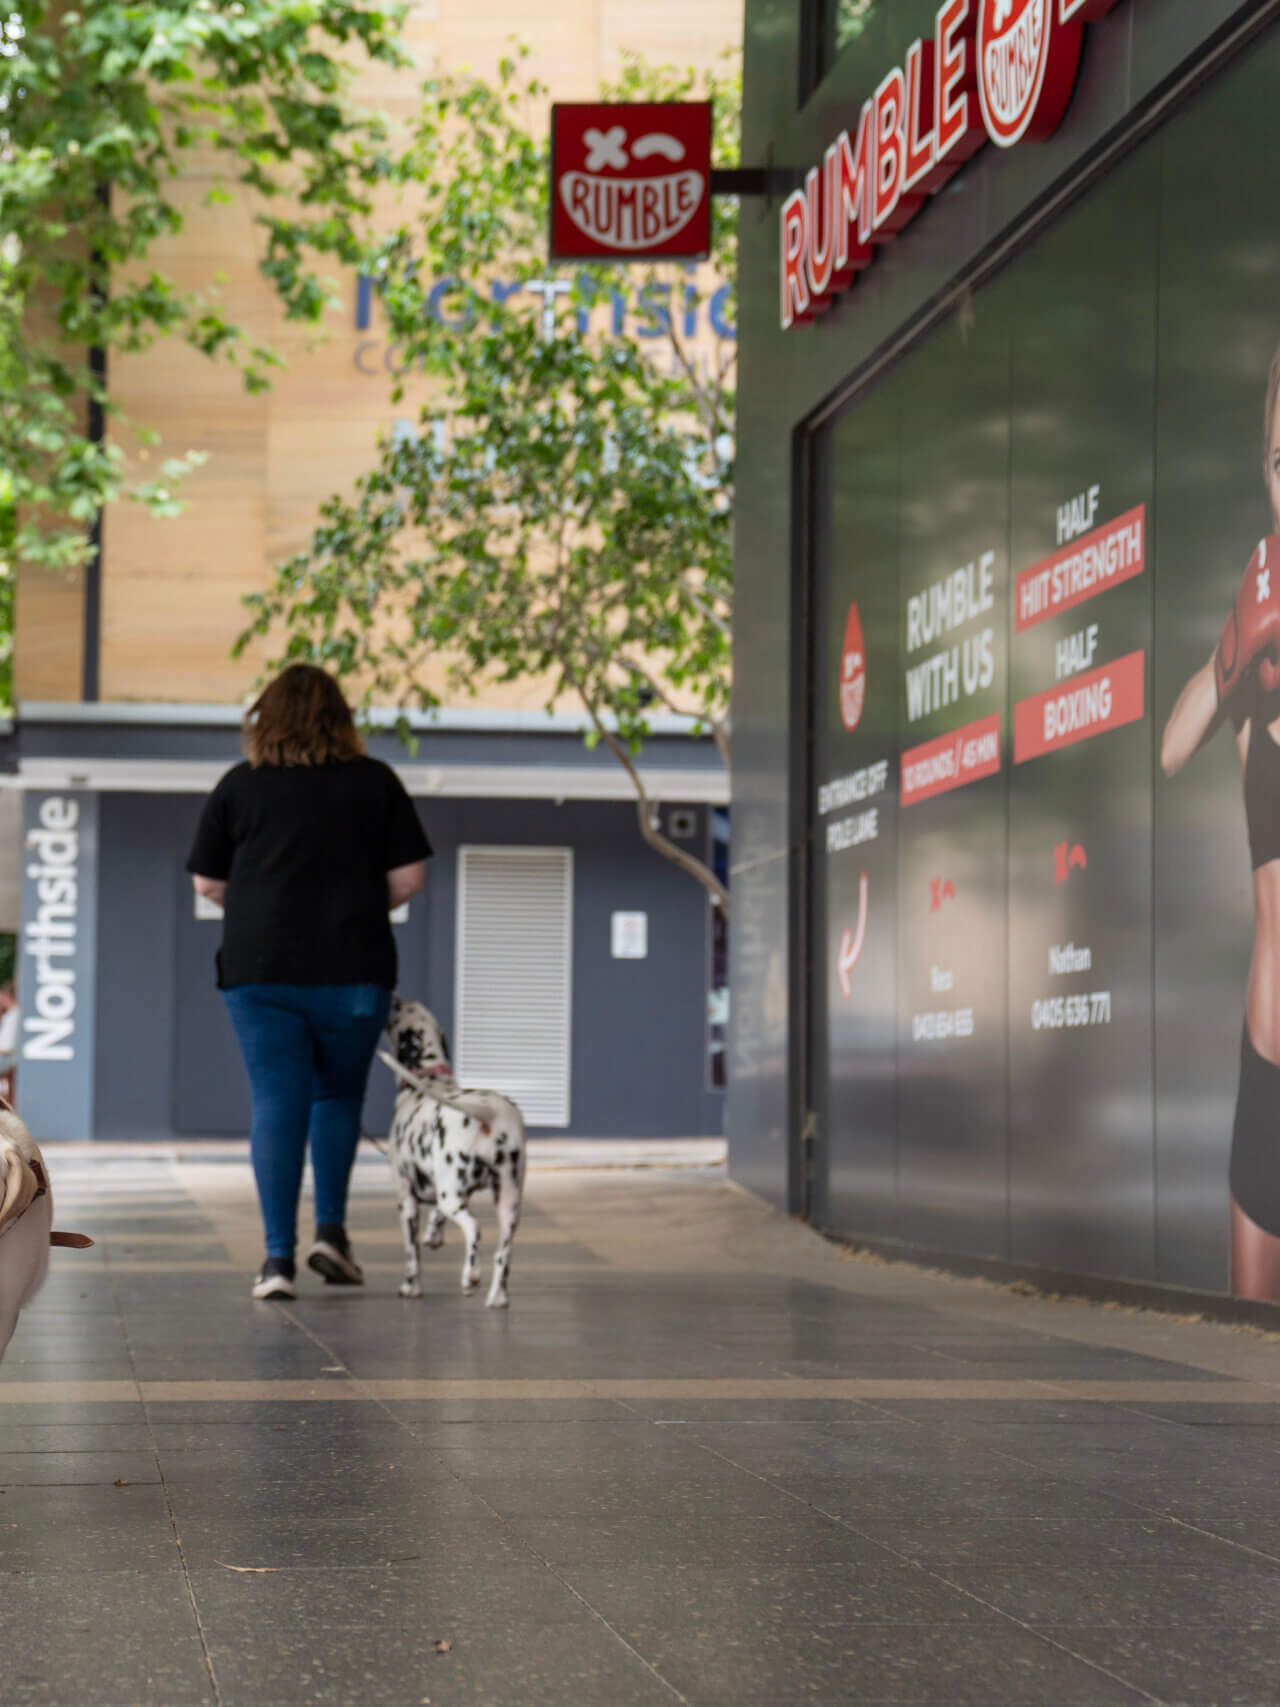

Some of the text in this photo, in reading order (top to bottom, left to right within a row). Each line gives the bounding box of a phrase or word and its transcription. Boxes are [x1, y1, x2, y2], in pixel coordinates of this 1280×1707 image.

[780, 0, 969, 330] RUMBLE
[571, 177, 693, 242] RUMBLE
[1057, 484, 1100, 545] HALF
[906, 550, 995, 652] RUMBLE
[1052, 520, 1141, 604] STRENGTH
[906, 652, 958, 722] WITH
[963, 629, 995, 697] US
[1056, 625, 1099, 679] HALF
[1044, 677, 1112, 741] BOXING
[22, 797, 80, 1061] Northside
